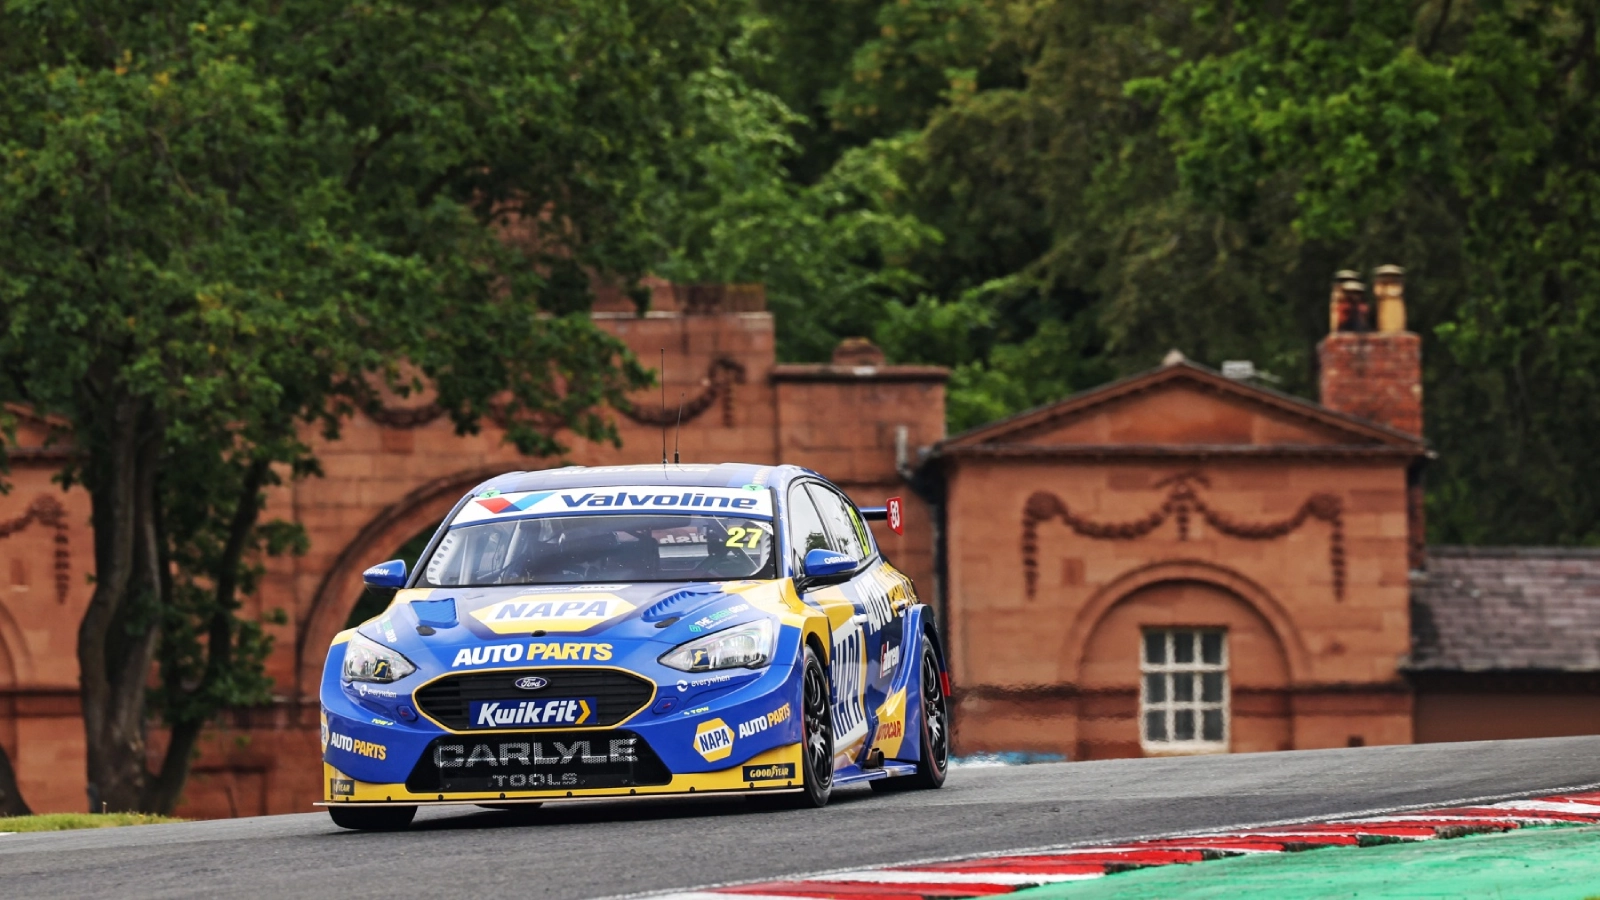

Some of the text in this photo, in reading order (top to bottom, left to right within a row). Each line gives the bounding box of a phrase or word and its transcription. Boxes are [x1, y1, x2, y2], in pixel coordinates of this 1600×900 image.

[561, 492, 757, 509] Valvoline
[726, 526, 763, 549] 27
[495, 601, 608, 620] NAPA
[694, 617, 714, 627] THE
[452, 642, 613, 667] AUTO PARTS
[521, 677, 541, 687] Ford
[691, 674, 730, 688] everywhen
[368, 688, 397, 698] everywhen
[690, 706, 709, 715] TOW
[738, 703, 791, 739] AUTO PARTS
[330, 731, 353, 752] AUTO
[353, 739, 387, 761] PARTS
[699, 728, 730, 752] NAPA
[433, 738, 638, 768] CARLYLE
[492, 773, 578, 787] TOOLS
